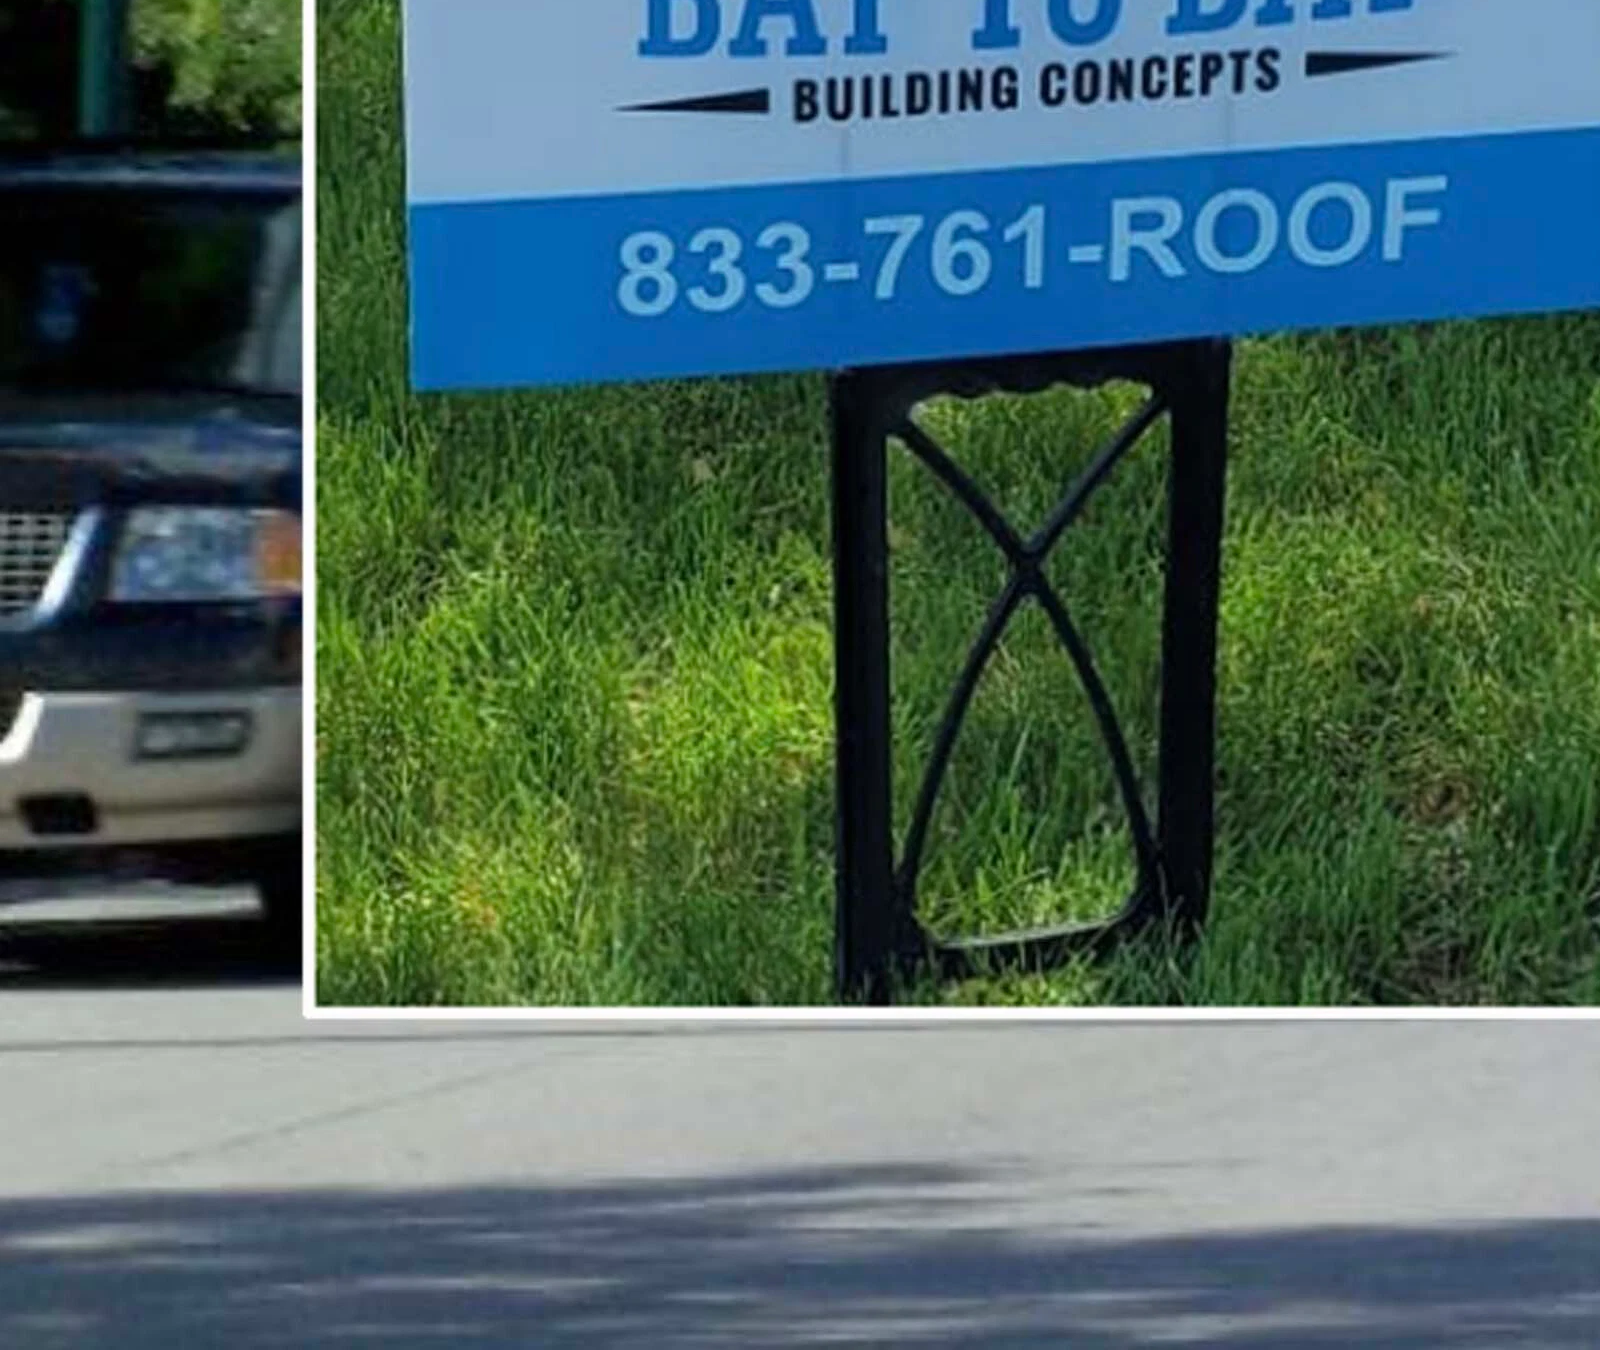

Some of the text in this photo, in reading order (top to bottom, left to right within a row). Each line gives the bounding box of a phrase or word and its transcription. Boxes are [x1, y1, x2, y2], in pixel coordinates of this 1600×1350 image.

[792, 47, 1282, 123] BUILDING CONCEPTS
[617, 175, 1448, 317] 833-761-ROOF
